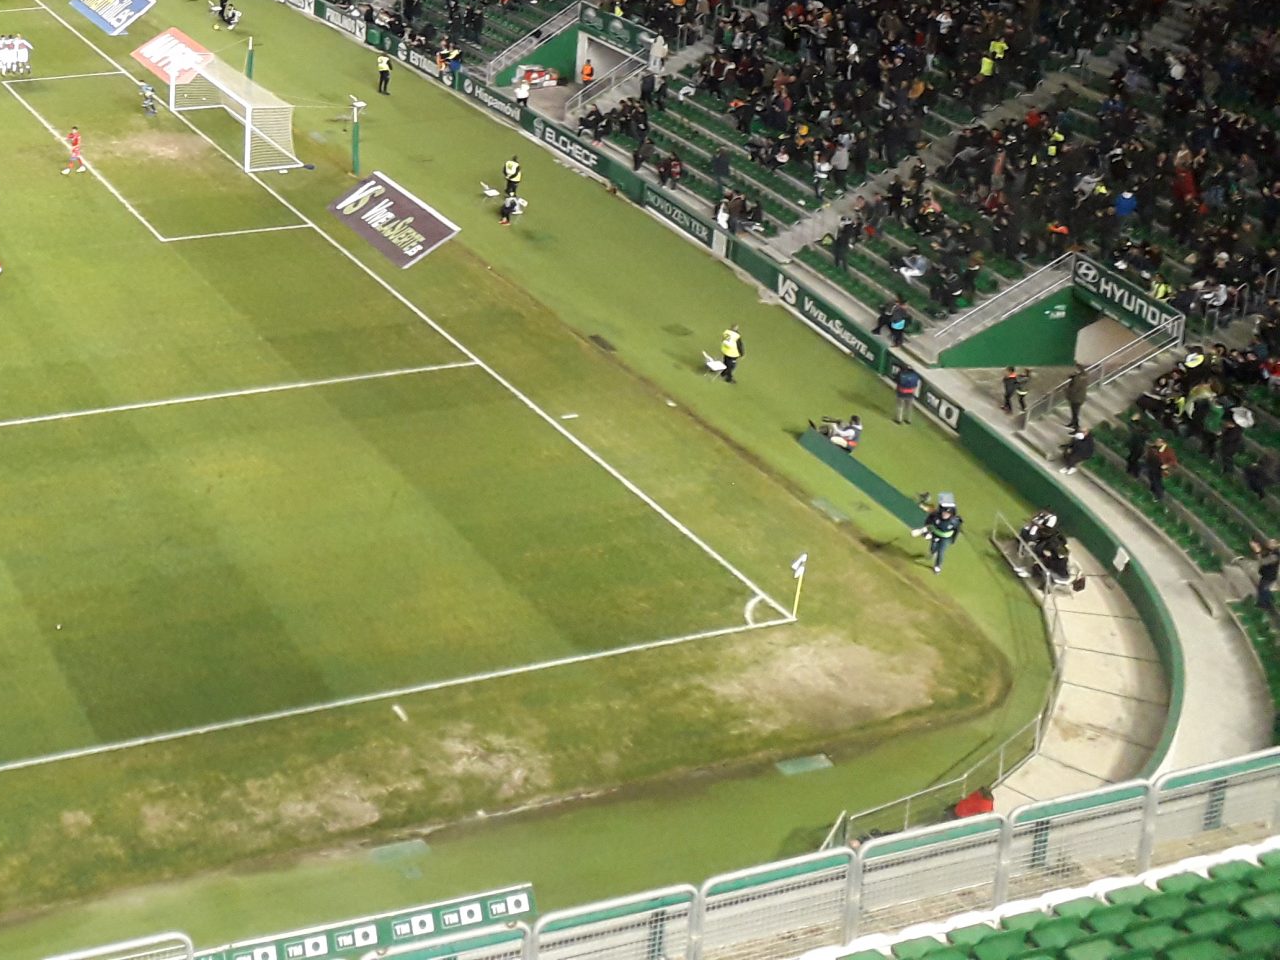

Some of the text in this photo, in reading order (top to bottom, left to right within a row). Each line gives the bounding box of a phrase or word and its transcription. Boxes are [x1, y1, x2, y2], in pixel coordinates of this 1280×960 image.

[474, 84, 521, 122] Hispamóvil
[336, 180, 386, 215] VS
[778, 273, 799, 305] VS
[1099, 277, 1179, 338] HYUNDAI
